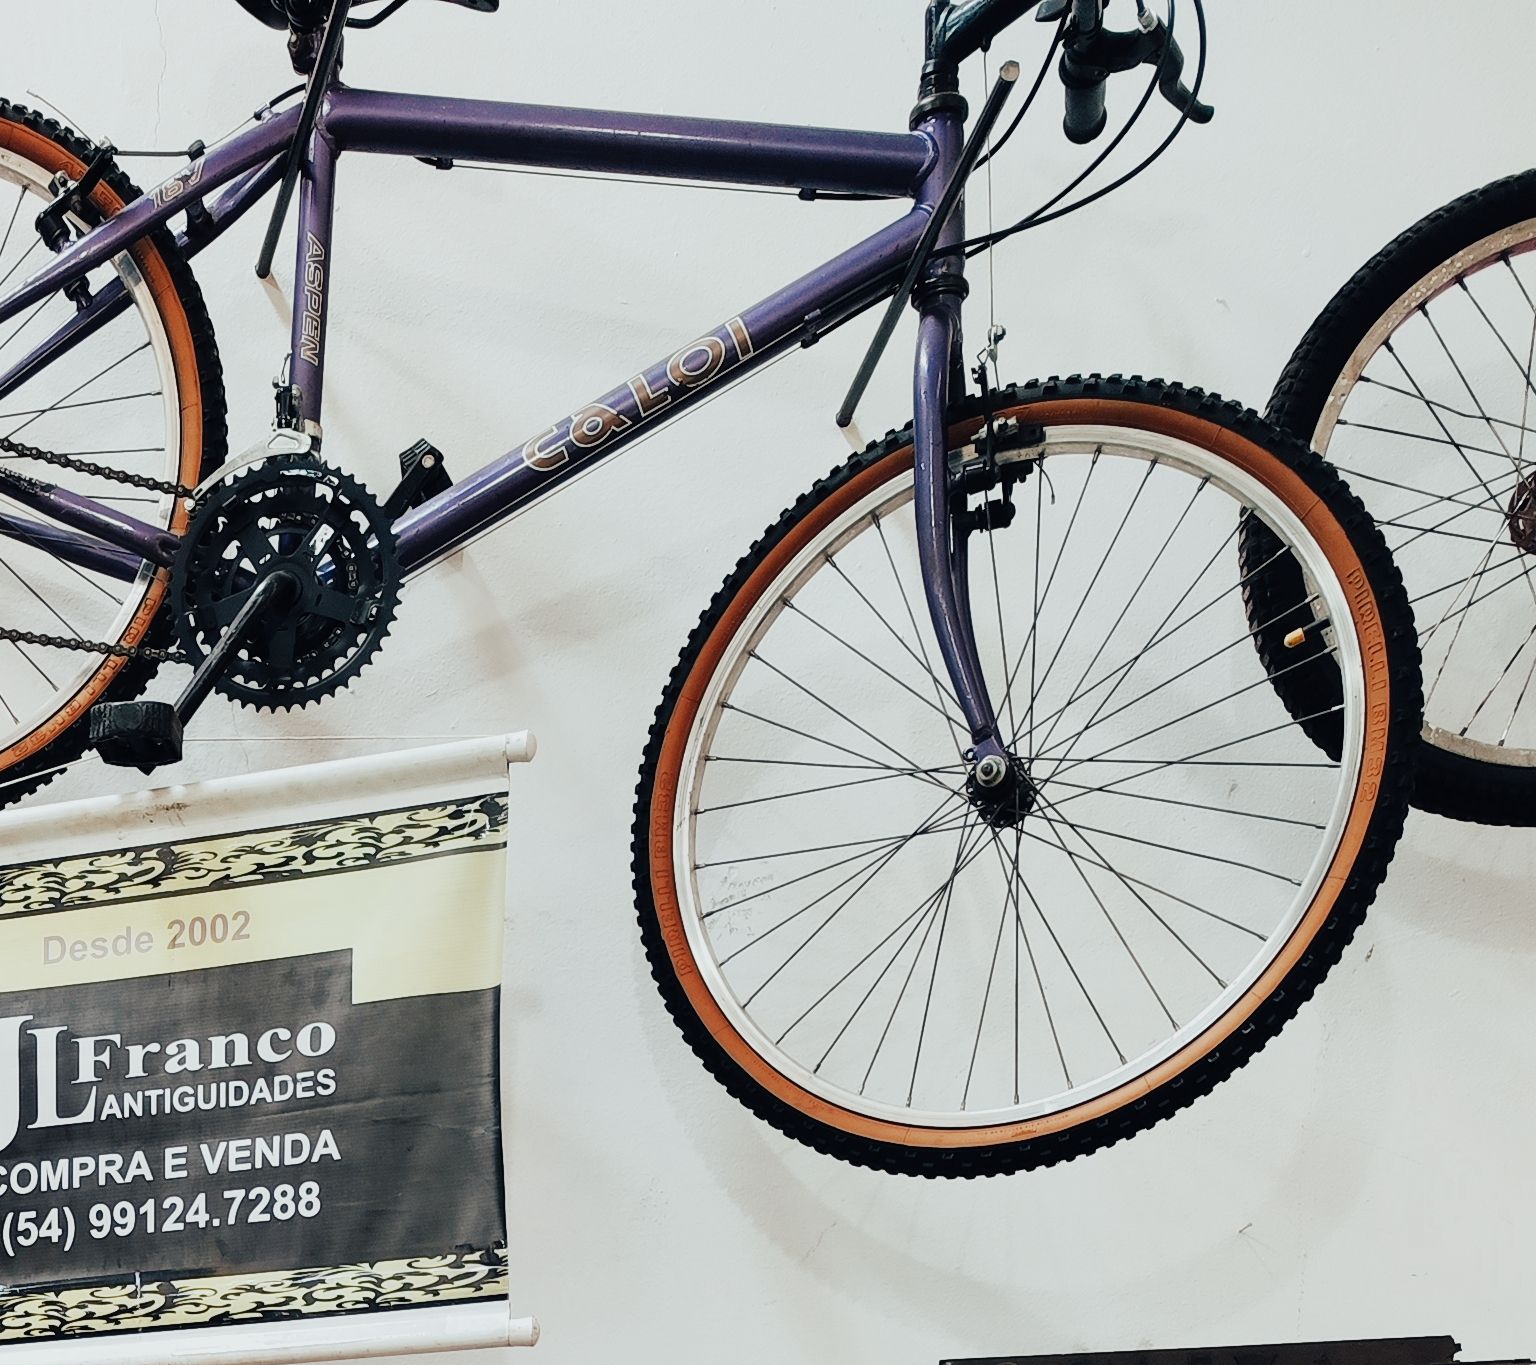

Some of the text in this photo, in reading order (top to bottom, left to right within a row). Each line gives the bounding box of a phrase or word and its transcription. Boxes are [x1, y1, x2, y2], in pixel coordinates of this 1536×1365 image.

[300, 231, 325, 367] ASPEN
[88, 597, 157, 697] PIRLLI
[1345, 567, 1388, 693] PIRELLI
[42, 910, 252, 966] Desde 2002
[70, 1020, 337, 1084] Franco
[99, 1068, 337, 1121] ANTIGUIDADES
[163, 1145, 188, 1180] E
[200, 1130, 341, 1175] VENDA
[1, 1180, 322, 1257] (54) 99124.7288
